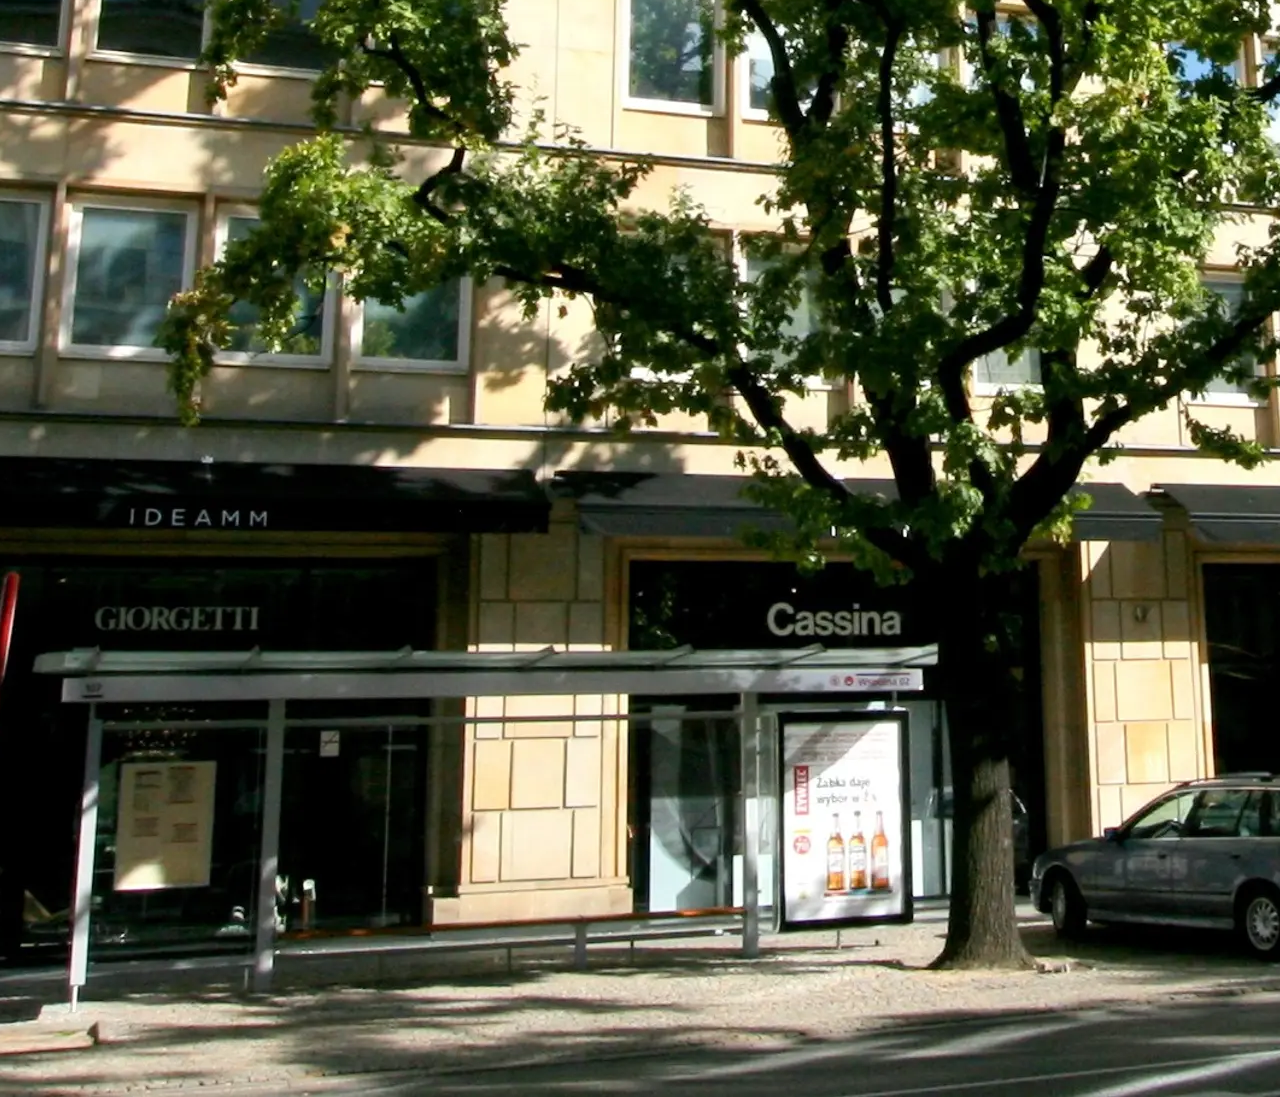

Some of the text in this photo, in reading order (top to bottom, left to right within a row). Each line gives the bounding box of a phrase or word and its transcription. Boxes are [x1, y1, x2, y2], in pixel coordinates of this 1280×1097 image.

[129, 507, 269, 527] IDEAMM
[94, 606, 260, 631] GIORGETTI
[767, 602, 902, 637] Cassina
